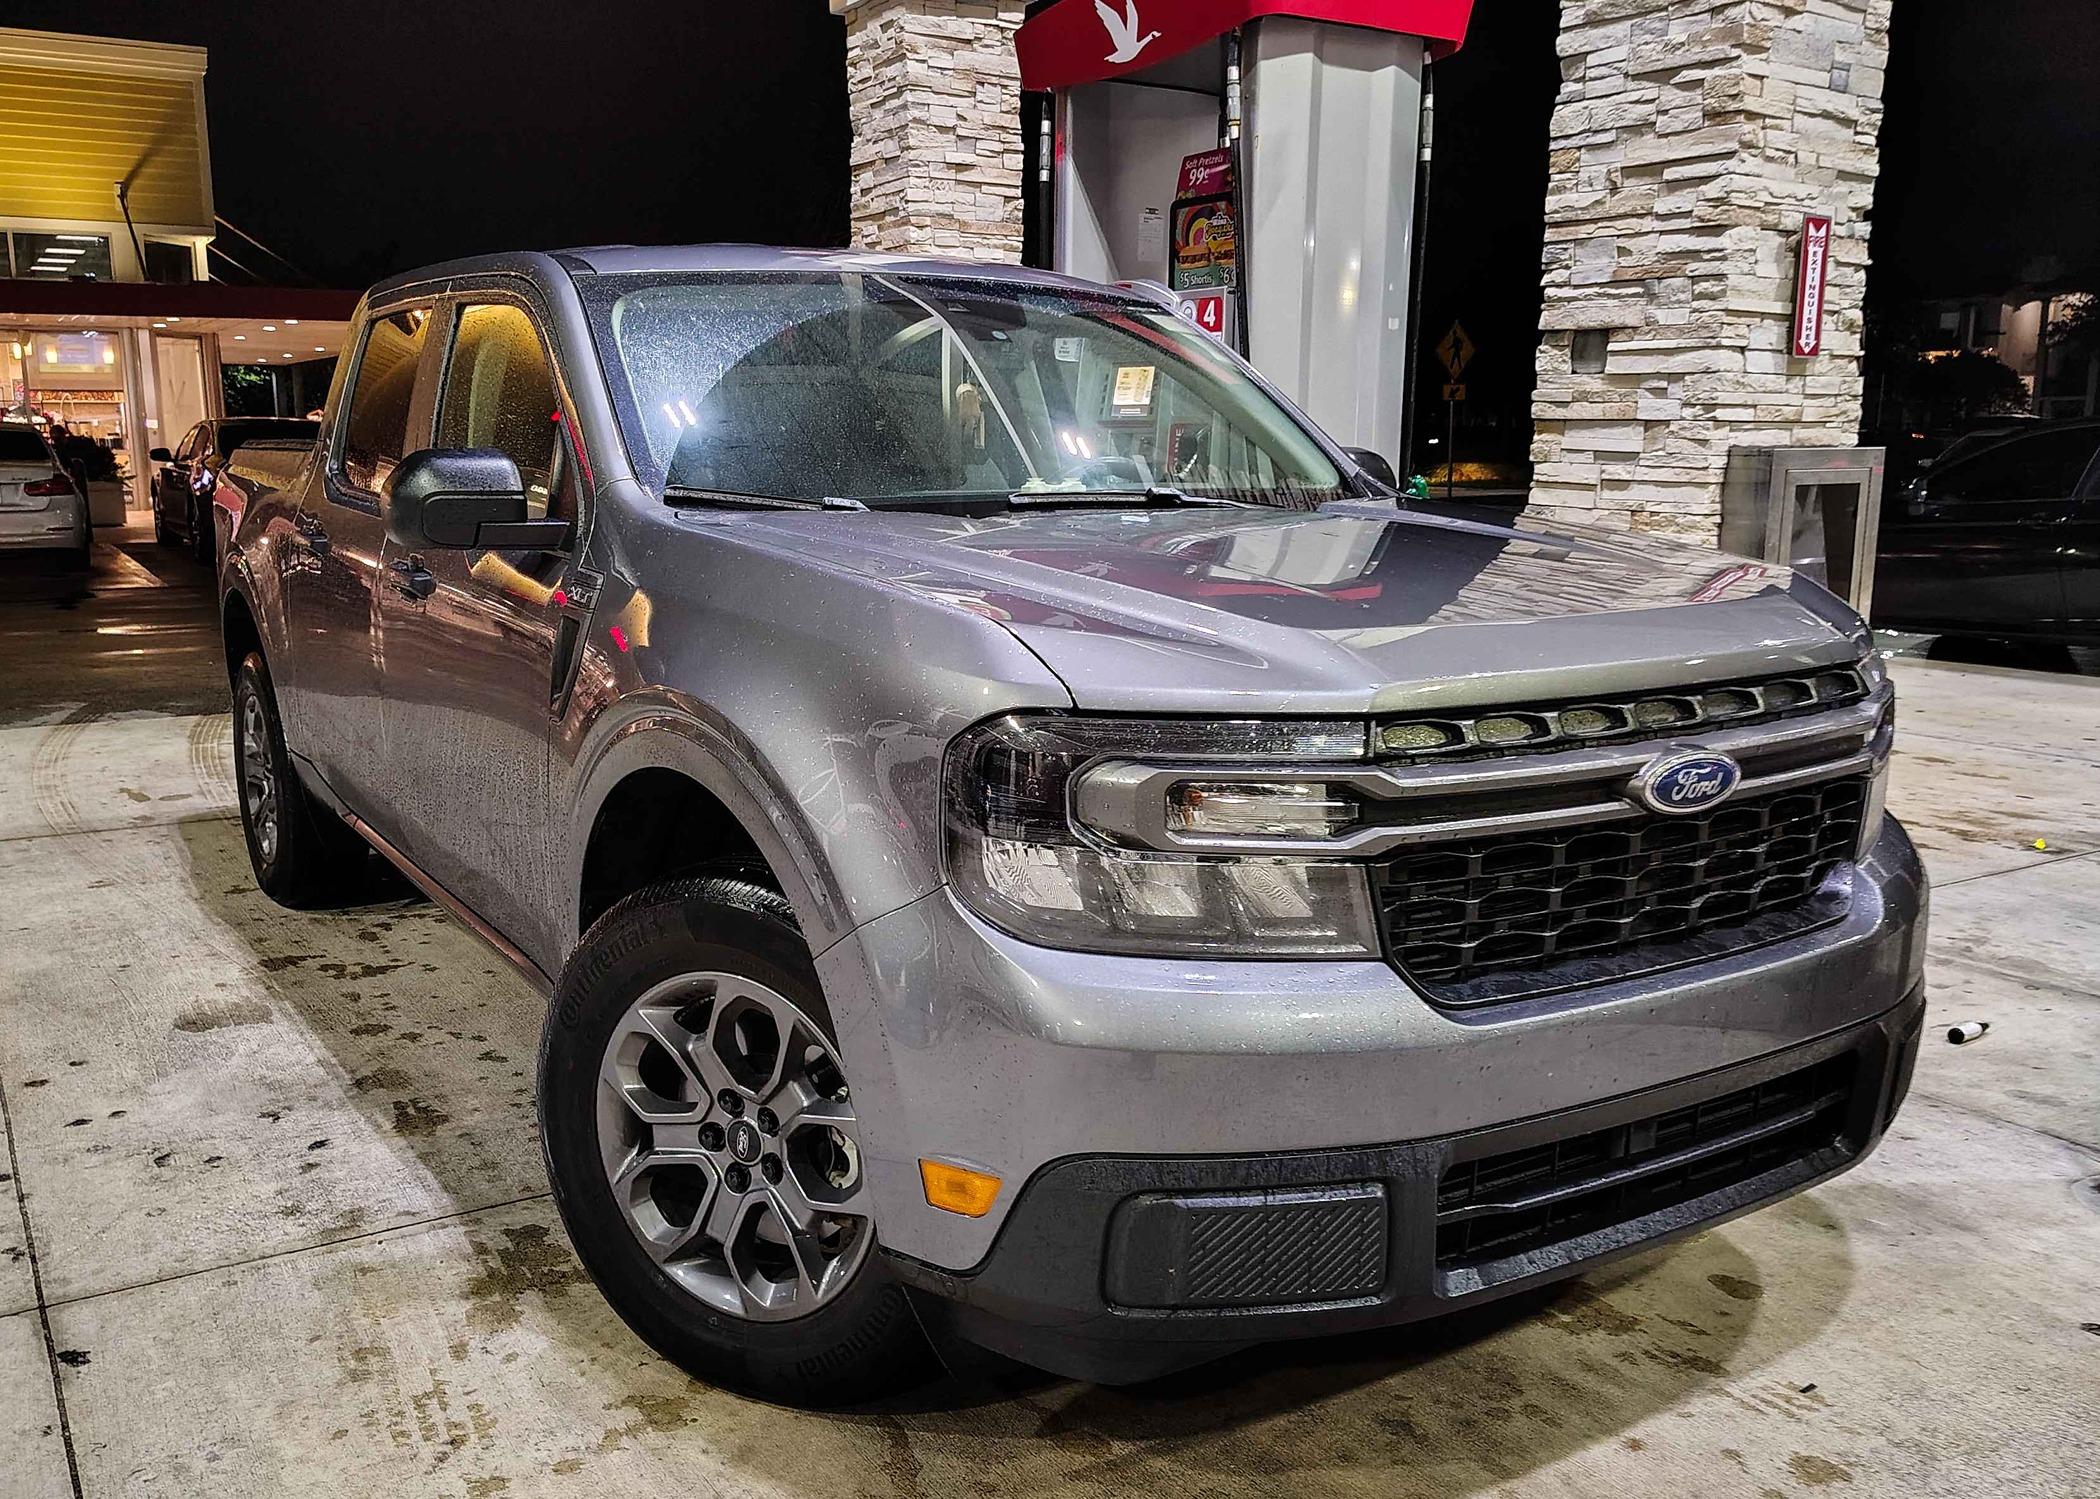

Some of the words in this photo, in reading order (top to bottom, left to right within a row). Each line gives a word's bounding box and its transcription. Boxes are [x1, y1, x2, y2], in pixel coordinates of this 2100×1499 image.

[1198, 153, 1224, 167] Pretzels
[1808, 235, 1827, 248] FIRE
[1179, 271, 1190, 288] $5
[1804, 250, 1819, 349] EXTINGUISHER
[1203, 299, 1216, 327] 4
[1671, 765, 1724, 801] Ford
